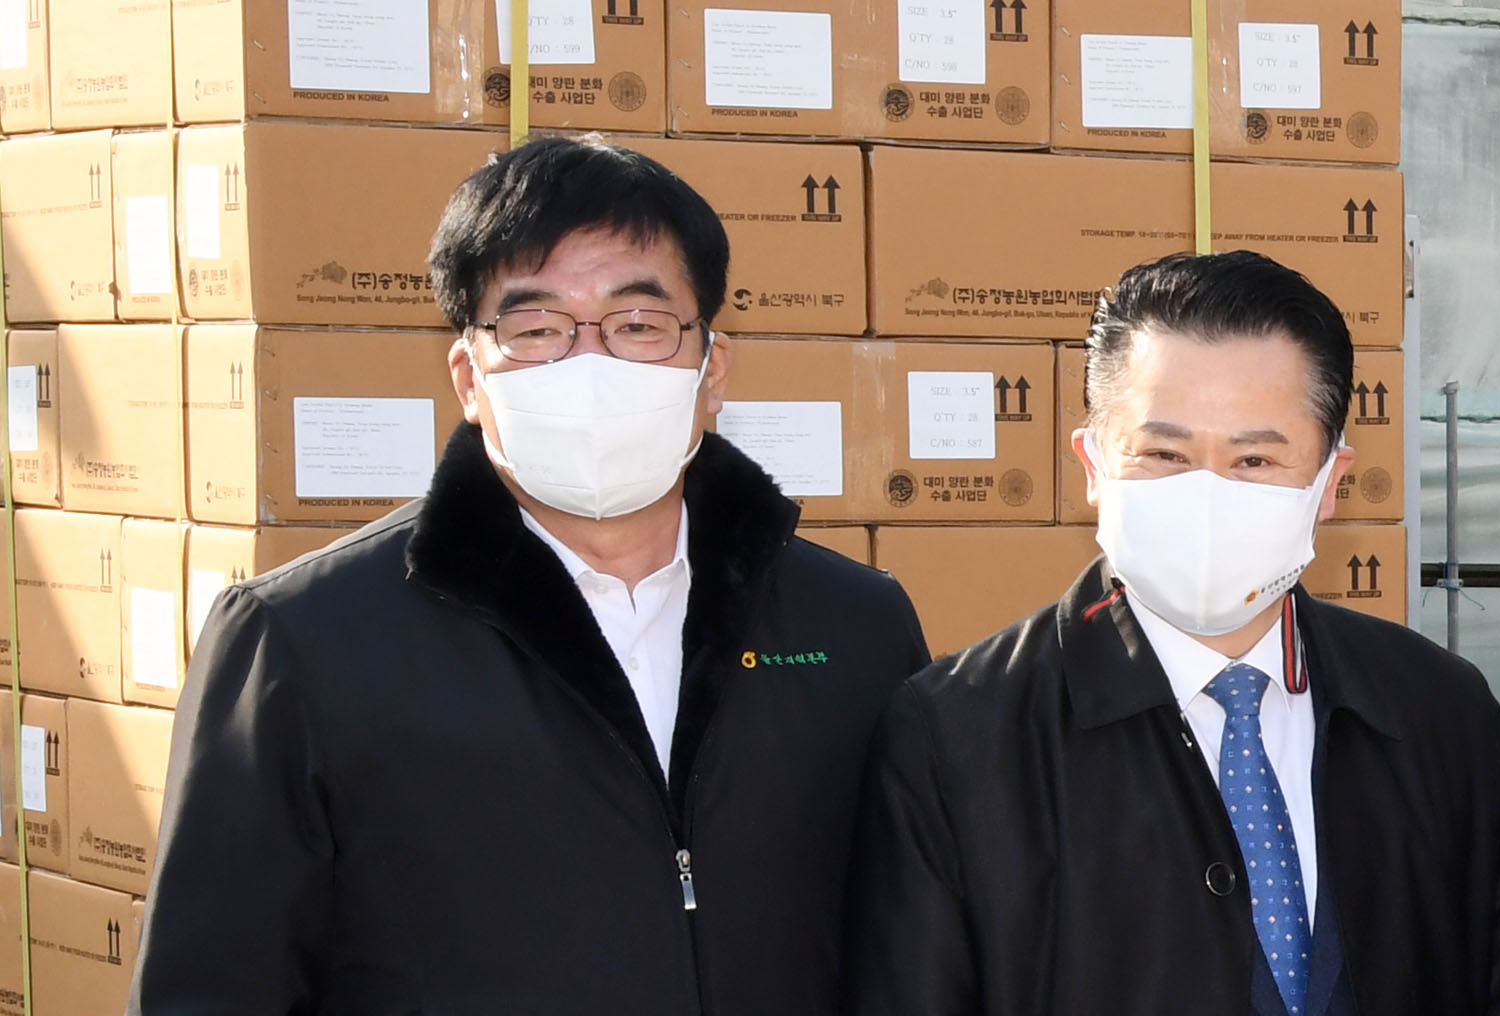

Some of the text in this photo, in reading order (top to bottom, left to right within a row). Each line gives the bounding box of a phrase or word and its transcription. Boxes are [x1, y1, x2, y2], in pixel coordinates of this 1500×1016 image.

[293, 91, 389, 102] PRODUCED IN KOREA
[533, 92, 595, 104] 수출 사업단
[919, 92, 990, 104] 대미 양란 분화
[711, 108, 798, 118] PRODUCED IN KOREA
[927, 106, 983, 119] 수출 사업단
[1277, 115, 1297, 127] 대미
[1323, 117, 1342, 129] 분화
[1087, 129, 1129, 137] PRODUCED
[1141, 130, 1167, 138] KOREA
[1283, 129, 1335, 142] 수출 사업단
[720, 213, 745, 221] EATER
[761, 214, 796, 222] FREEZER
[1080, 229, 1114, 238] STORAGE
[1224, 233, 1243, 241] AWAY
[1267, 234, 1294, 242] HEATER
[1308, 235, 1339, 243] FREEZER
[759, 292, 845, 308] 울산광역시 북구
[1359, 311, 1380, 325] 북구
[923, 476, 994, 488] 대미 양란 분화
[930, 490, 987, 502] 수출 사업단
[298, 498, 394, 507] PRODUCED IN KOREA
